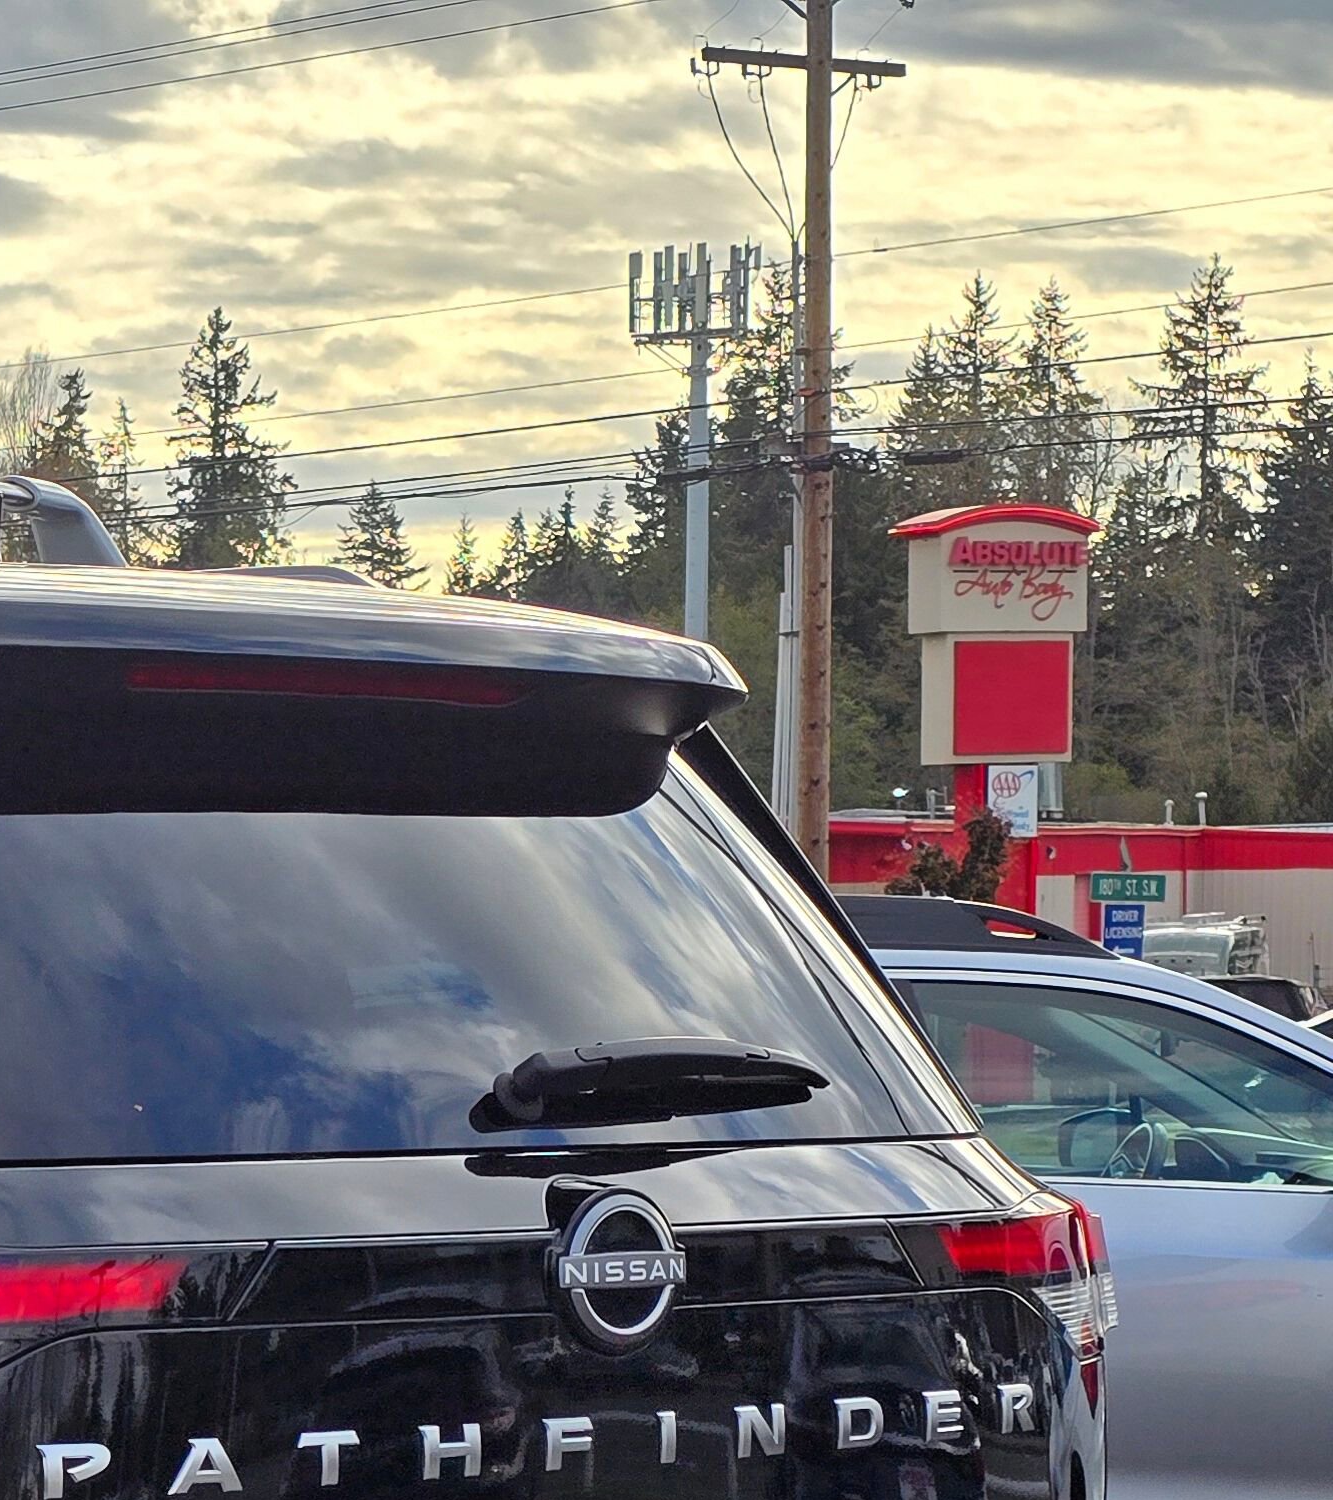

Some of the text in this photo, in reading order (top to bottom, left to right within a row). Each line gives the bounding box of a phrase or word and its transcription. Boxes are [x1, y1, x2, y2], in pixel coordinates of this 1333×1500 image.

[949, 536, 1089, 567] ABSOLUTE
[954, 563, 1074, 621] Auto Body
[1111, 910, 1139, 922] DRIVER
[1105, 926, 1143, 939] LICENSING
[564, 1257, 684, 1285] NISSAN
[36, 1383, 1035, 1500] PATHFINDER
